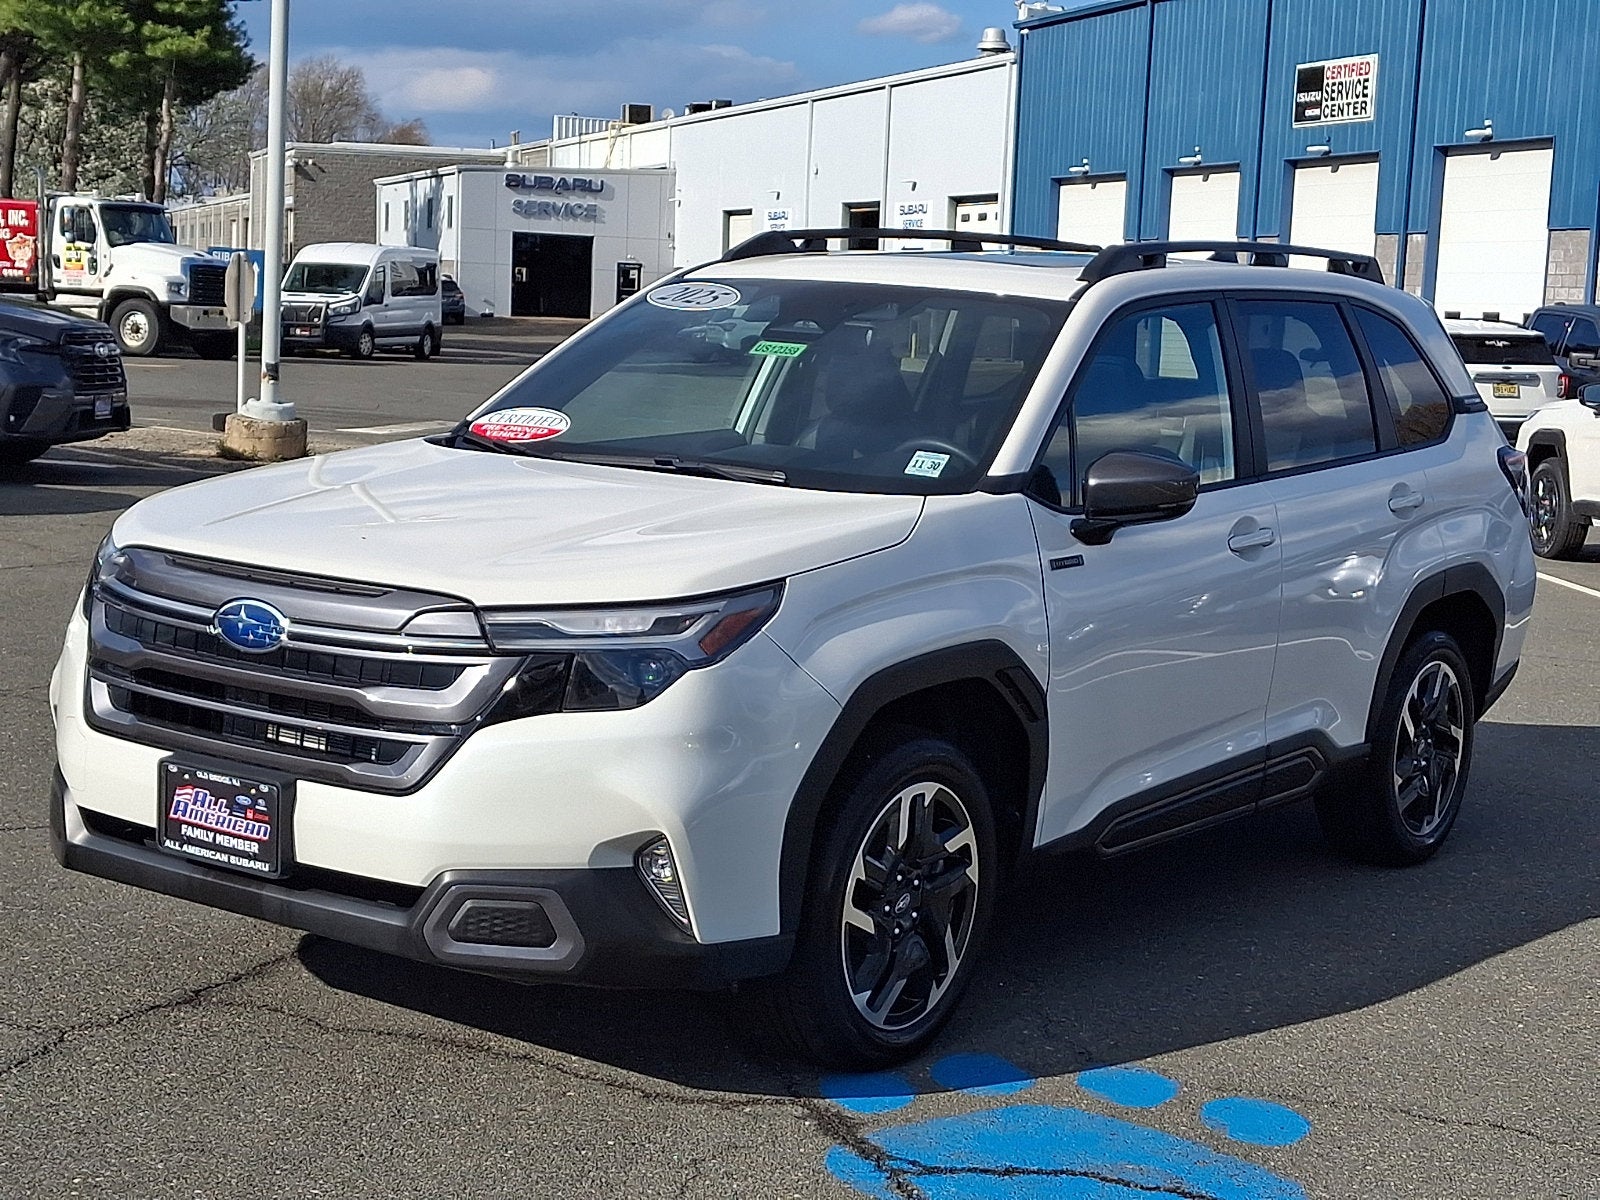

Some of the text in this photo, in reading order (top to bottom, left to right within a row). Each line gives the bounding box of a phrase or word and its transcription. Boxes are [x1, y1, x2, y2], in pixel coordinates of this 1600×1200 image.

[1326, 61, 1371, 80] CERTIFIED
[1297, 91, 1322, 102] ISUZU
[1324, 78, 1369, 102] SERVICE
[1323, 101, 1368, 119] CENTER
[505, 173, 604, 193] SUBARU
[512, 199, 598, 218] SERVICE
[768, 211, 789, 221] SUBARU
[900, 203, 928, 215] SUBARU
[8, 209, 29, 226] INC.
[903, 218, 924, 229] SERVICE
[657, 286, 732, 305] 2025
[488, 412, 563, 427] CERTIFIED
[482, 424, 549, 434] PRE-OWNED
[484, 430, 531, 439] VEHICLE
[912, 459, 941, 471] 11 30
[196, 770, 209, 780] OLD
[190, 788, 230, 816] ALL
[170, 799, 271, 841] AMERICAN
[181, 824, 259, 854] FAMILY MEMBER
[165, 839, 270, 872] ALL AMERICAN SUBARU
